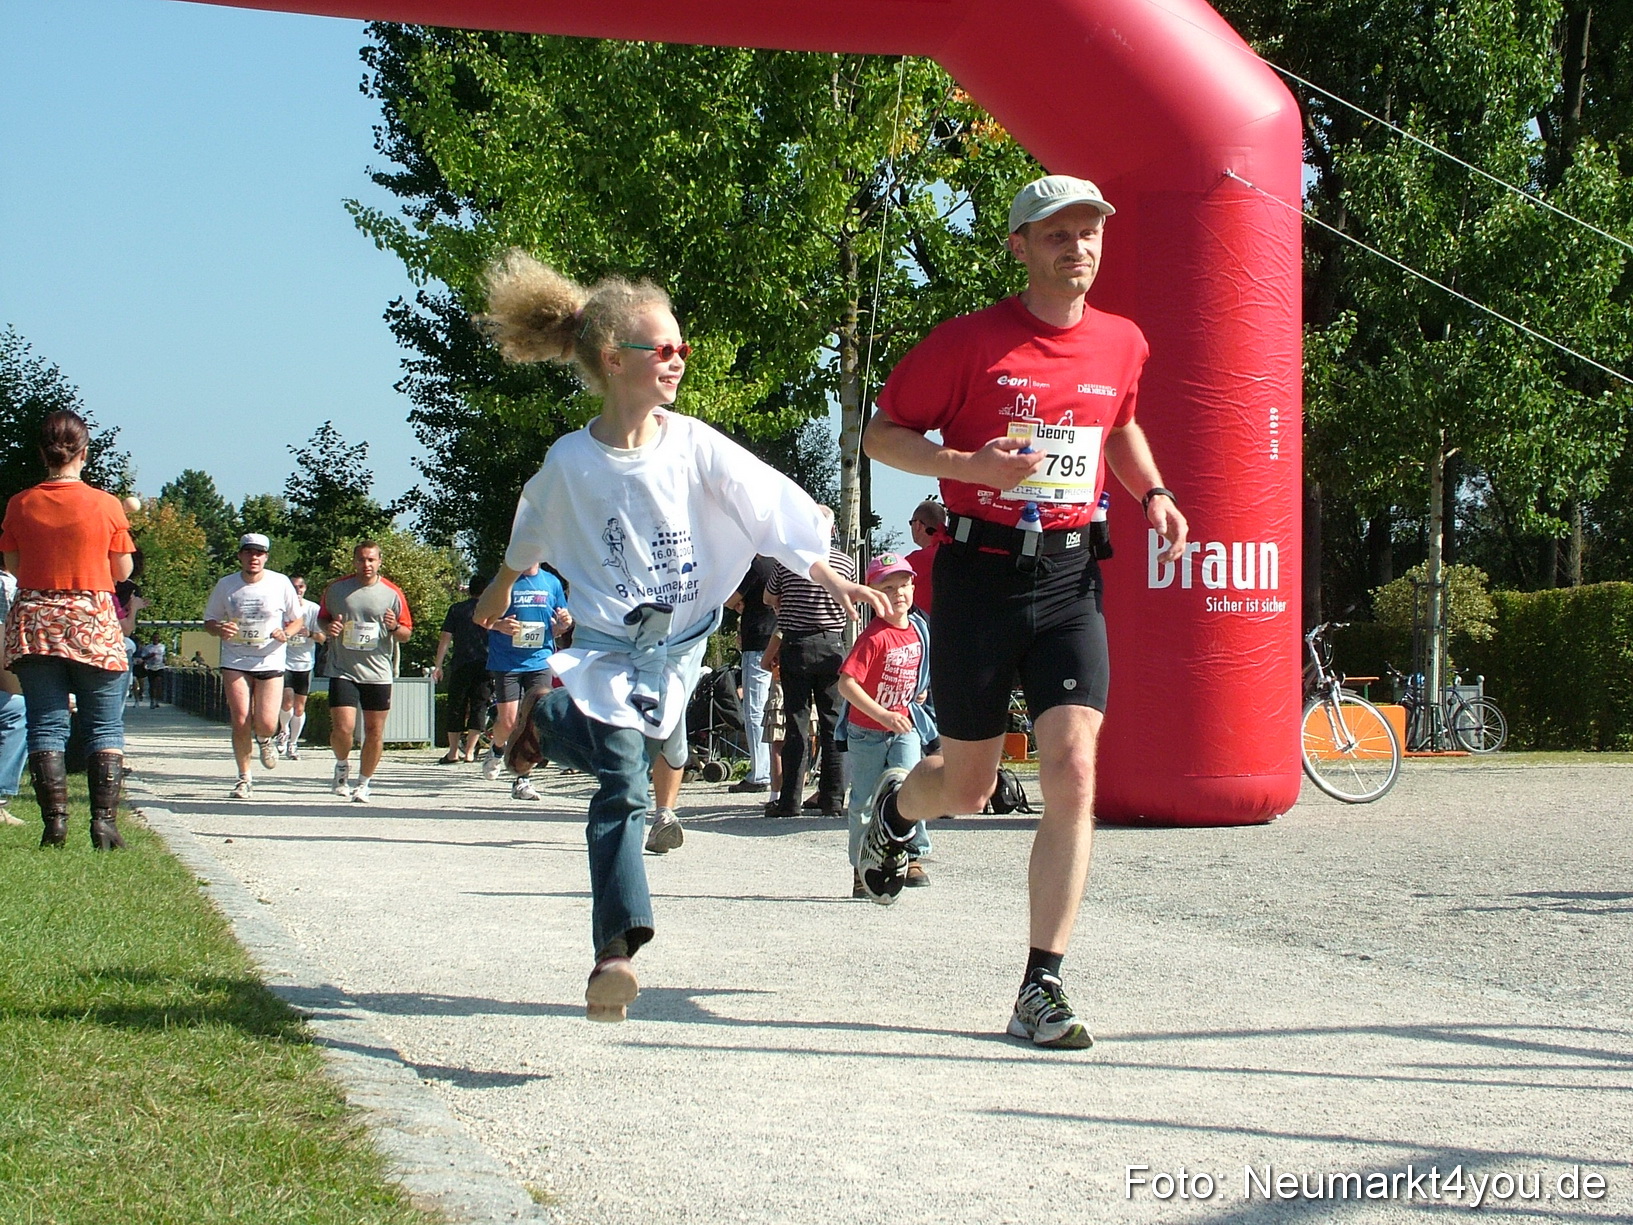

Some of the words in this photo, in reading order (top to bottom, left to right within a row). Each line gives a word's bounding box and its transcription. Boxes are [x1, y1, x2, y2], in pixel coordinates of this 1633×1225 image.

[1269, 407, 1279, 435] 1929
[1036, 425, 1075, 444] Georg
[1269, 438, 1279, 460] Seit
[1046, 454, 1087, 477] 795
[1147, 528, 1279, 590] Braun
[615, 583, 635, 598] 8.
[1206, 596, 1243, 613] Sicher
[1246, 596, 1260, 612] ist
[1261, 596, 1287, 612] sicher
[242, 630, 259, 638] 762
[359, 634, 371, 644] 79
[525, 633, 539, 641] 907
